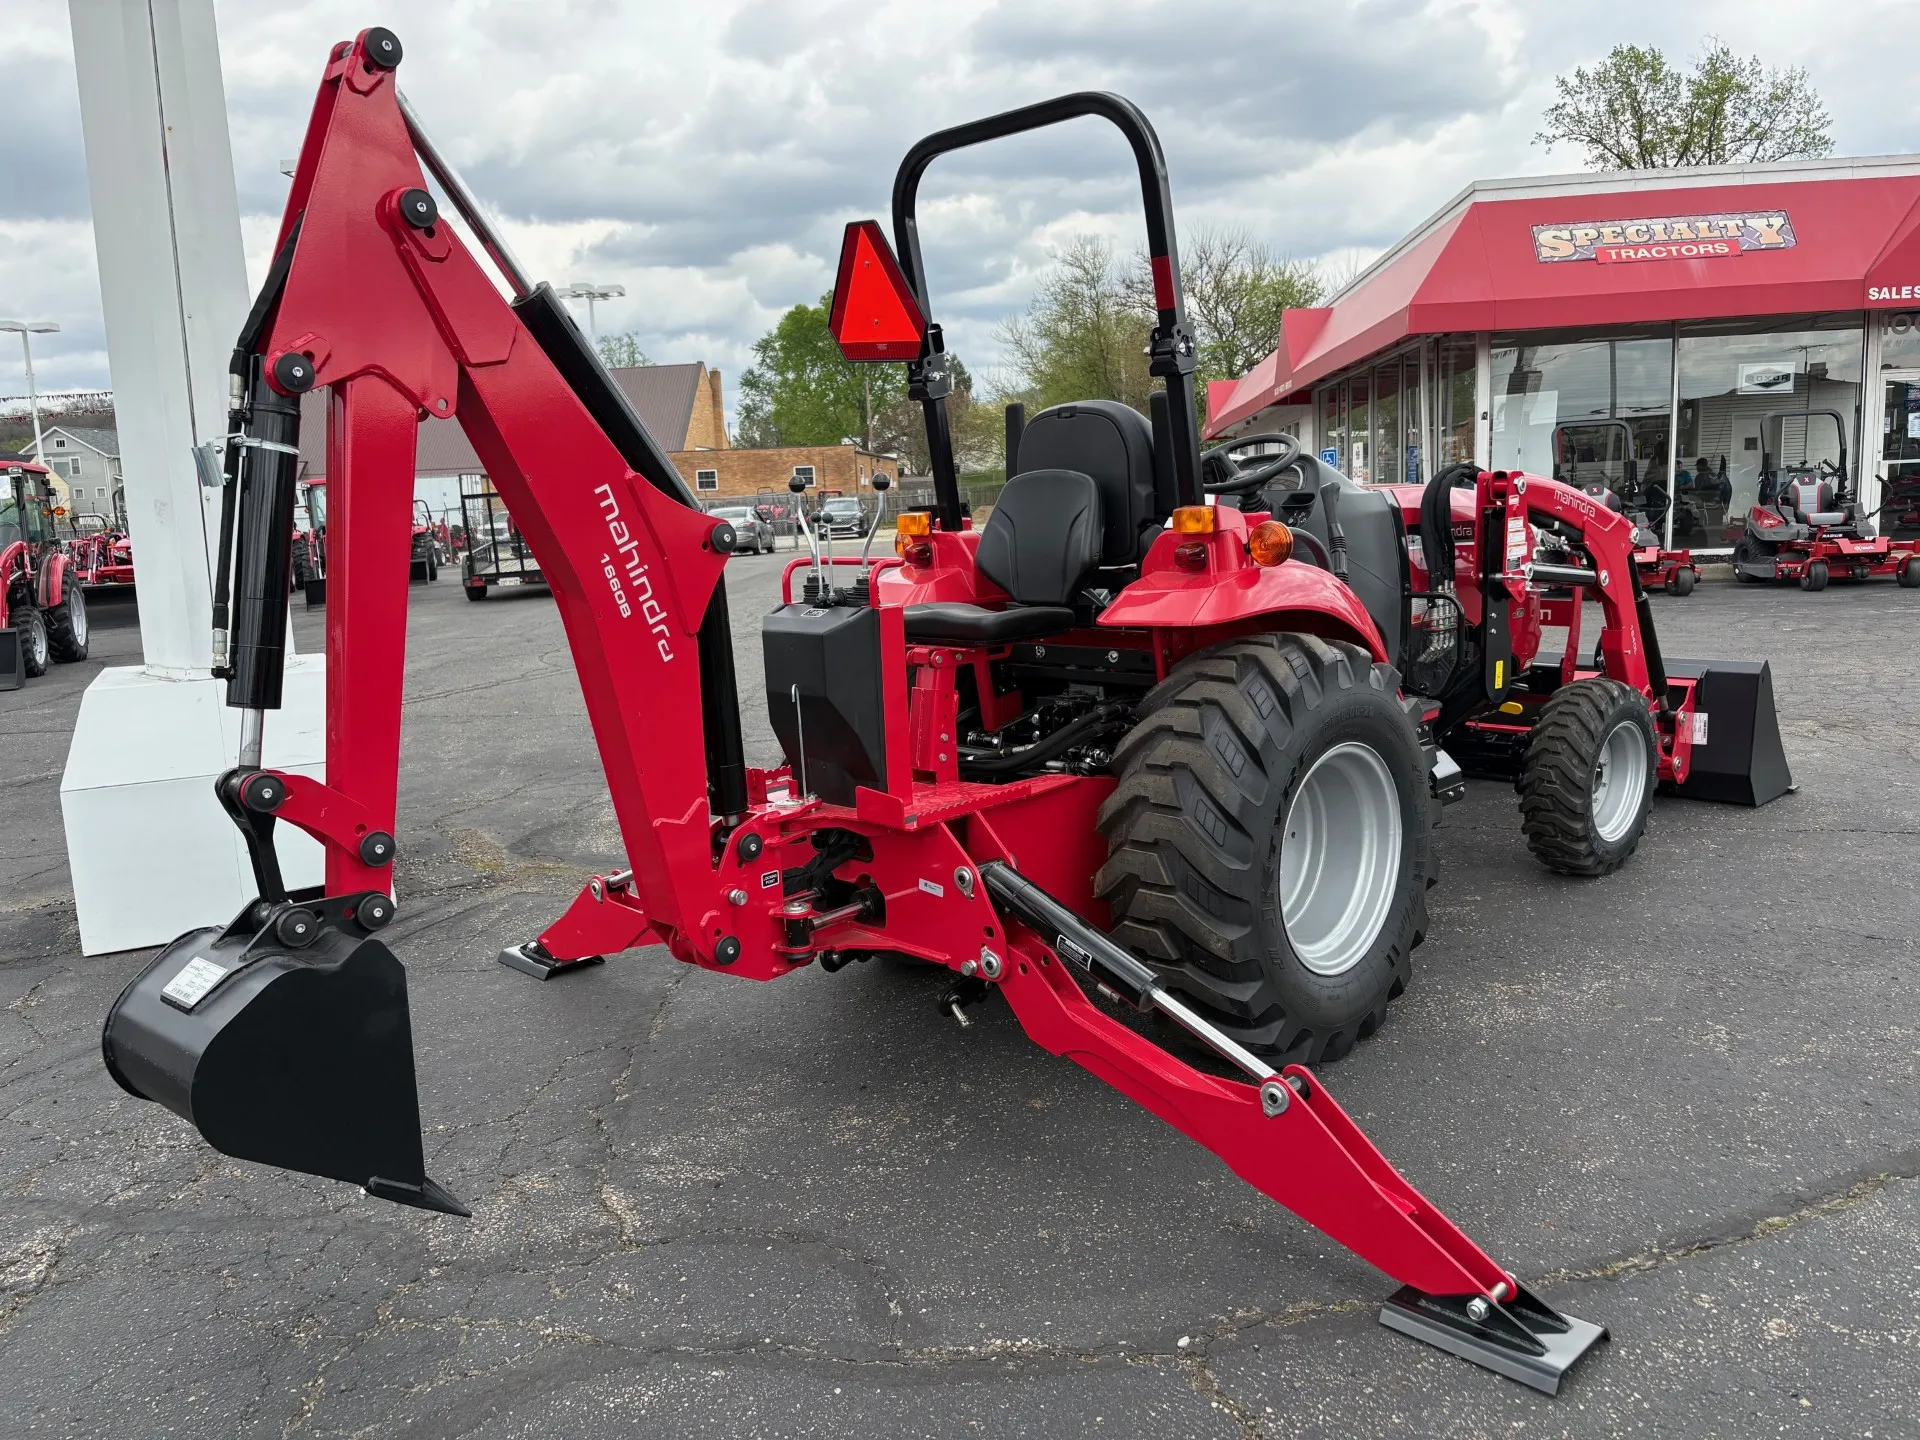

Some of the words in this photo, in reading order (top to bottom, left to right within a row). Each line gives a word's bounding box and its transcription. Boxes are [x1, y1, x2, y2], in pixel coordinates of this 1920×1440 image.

[1537, 217, 1786, 258] SPECIALTY
[1606, 243, 1730, 260] TRACTORS
[1868, 285, 1920, 300] SALES
[1746, 374, 1789, 382] ROXOR
[1554, 490, 1596, 518] mahindra
[594, 483, 674, 663] mahindra
[600, 552, 632, 619] 1660B
